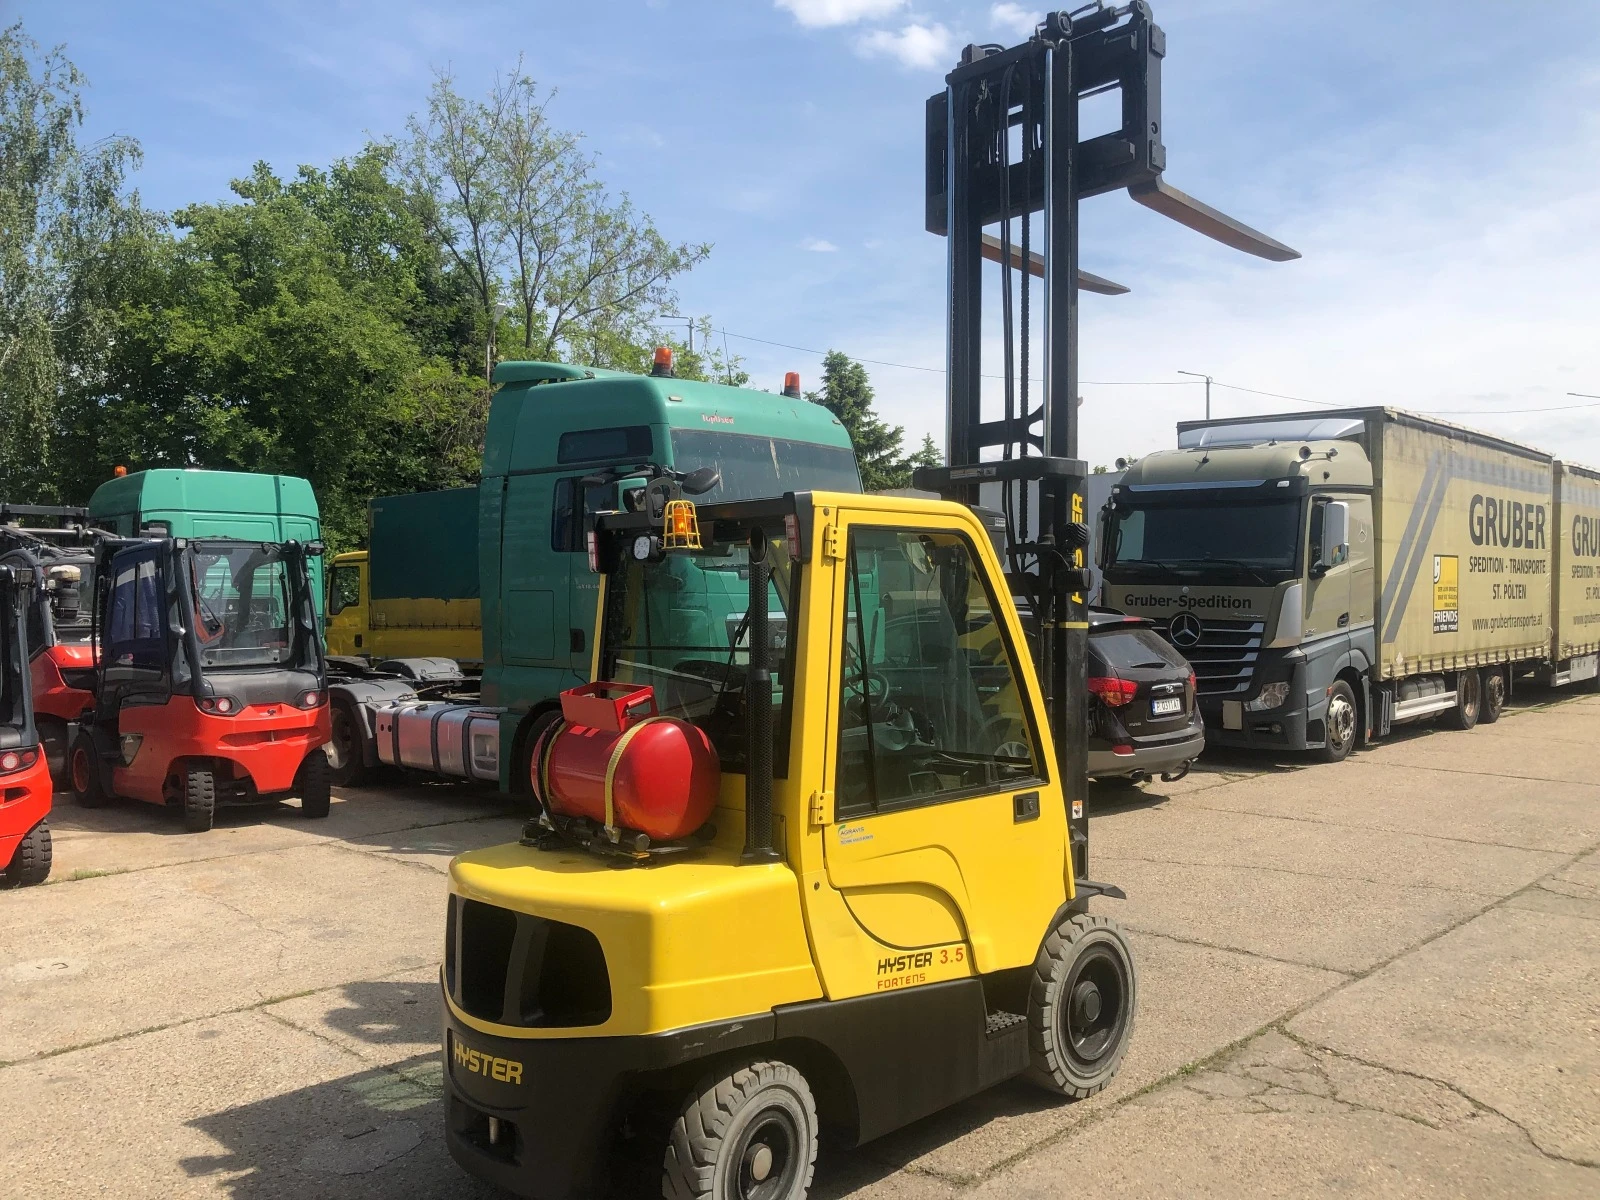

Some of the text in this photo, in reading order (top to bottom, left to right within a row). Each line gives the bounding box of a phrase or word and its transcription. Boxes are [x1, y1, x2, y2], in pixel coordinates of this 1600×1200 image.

[1469, 494, 1546, 550] GRUBER
[1572, 514, 1600, 557] GRU
[1469, 556, 1504, 573] SPEDITION
[1509, 558, 1546, 574] TRANSPORTE
[1492, 583, 1502, 600] ST.
[1124, 594, 1252, 610] Gruber-Spedition
[1433, 610, 1458, 623] FRIENDS
[1471, 612, 1543, 633] www.grubertransporte.at
[877, 947, 964, 975] HYSTER 3.5
[877, 973, 926, 990] FORTENS
[454, 1038, 523, 1085] HYSTER
